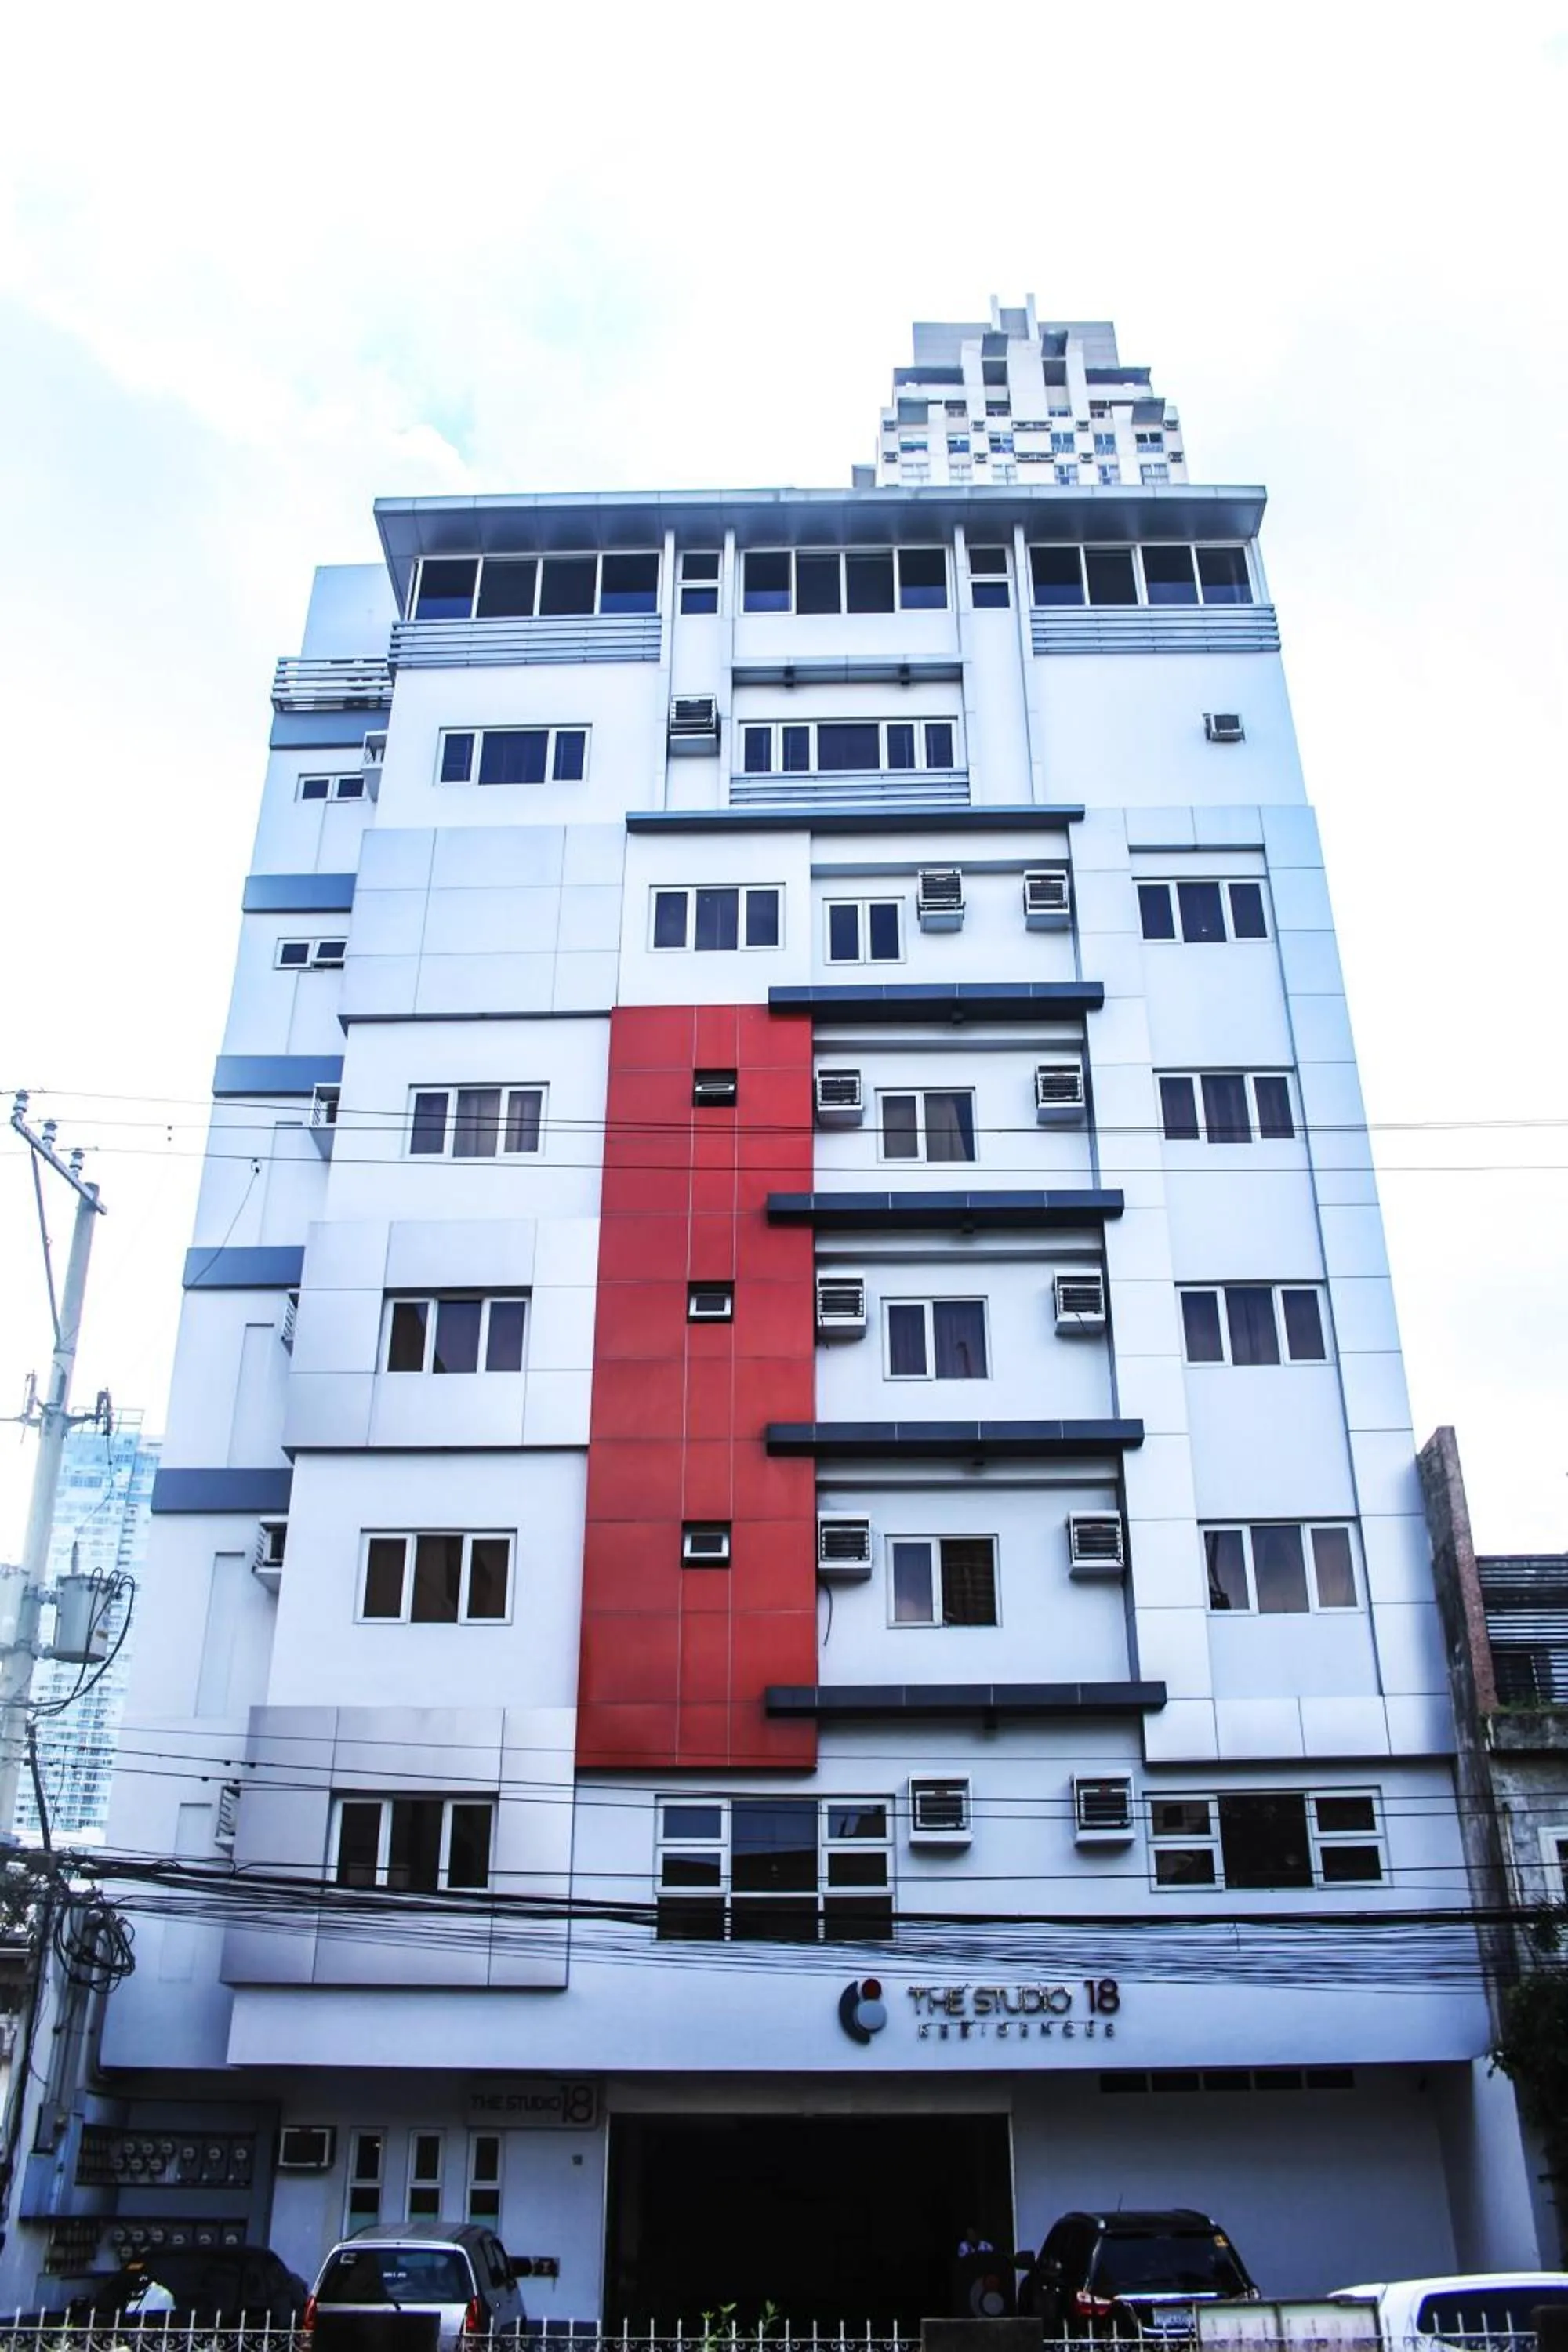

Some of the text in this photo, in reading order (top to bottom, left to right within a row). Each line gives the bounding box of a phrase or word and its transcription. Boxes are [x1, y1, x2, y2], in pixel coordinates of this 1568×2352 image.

[907, 1978, 1120, 2015] THE STUDIO 18
[470, 2084, 593, 2123] THE STUDIO 18
